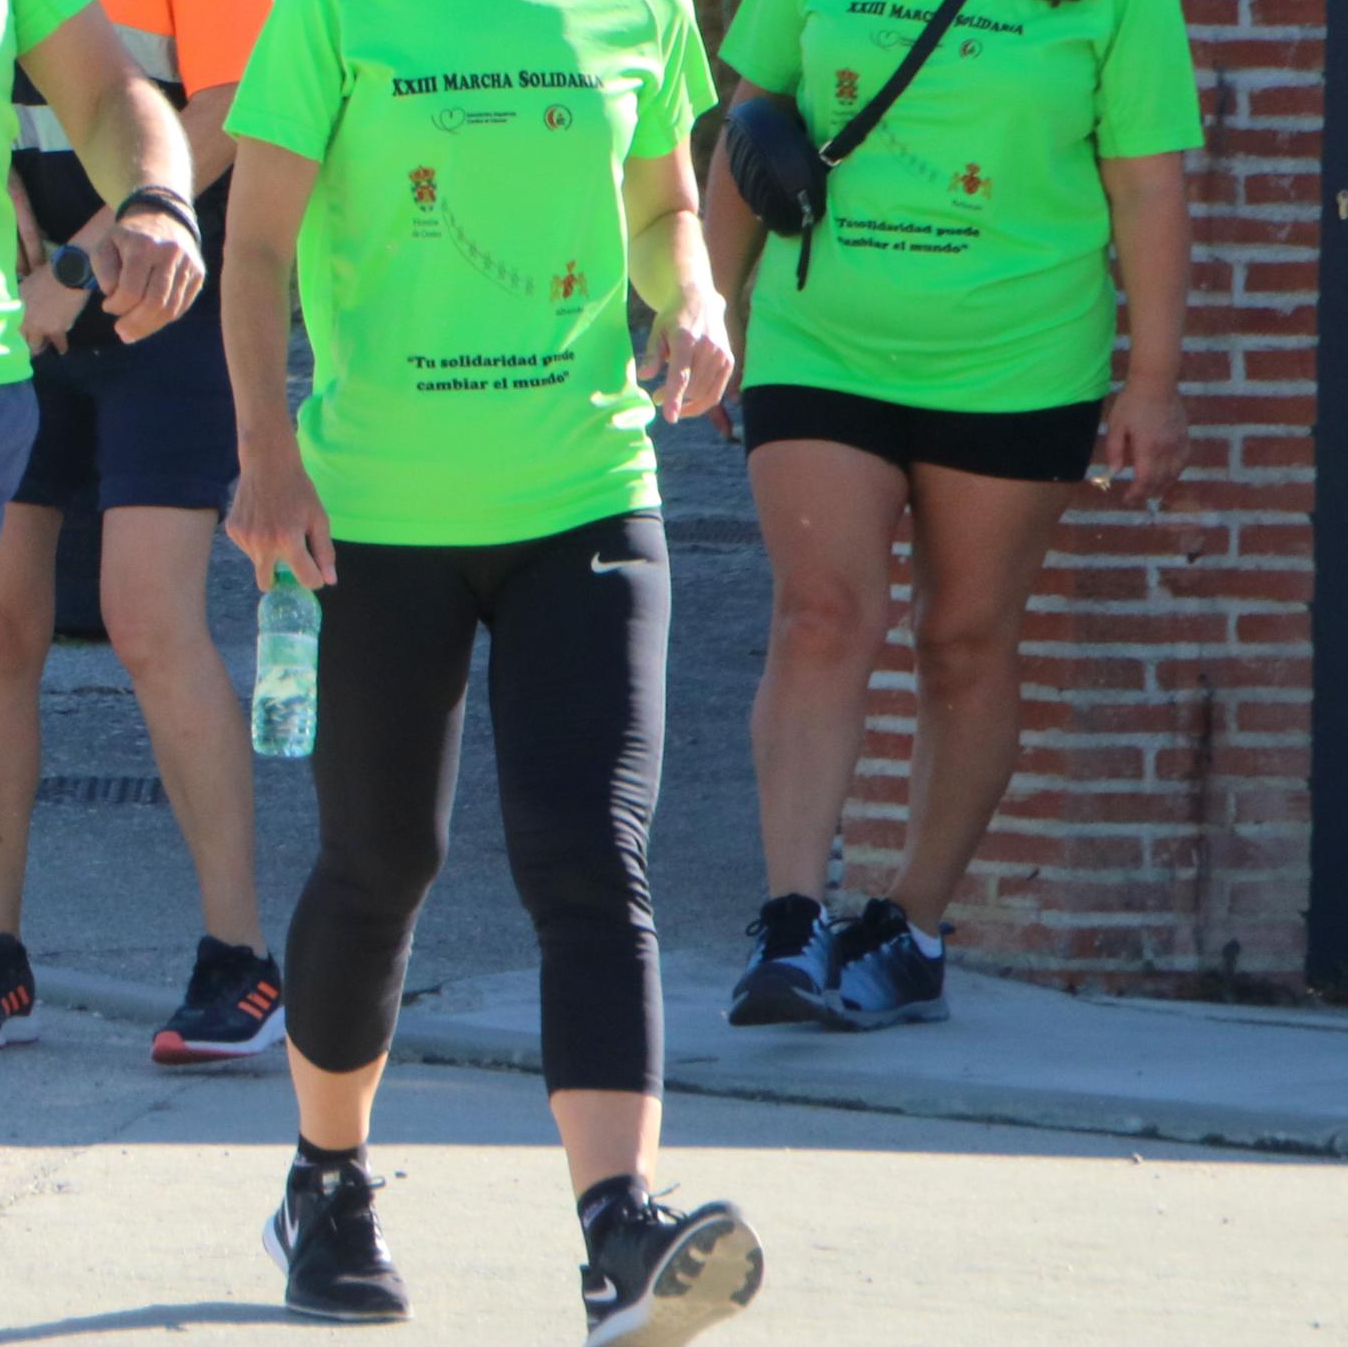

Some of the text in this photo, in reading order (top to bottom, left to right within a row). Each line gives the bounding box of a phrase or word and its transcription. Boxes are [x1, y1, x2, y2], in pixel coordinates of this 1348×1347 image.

[847, 1, 886, 16] XXIII
[392, 76, 438, 97] XXIII
[443, 72, 513, 92] MARCHA
[892, 240, 906, 251] el
[440, 353, 537, 369] solidaridad
[417, 377, 488, 392] cambiar
[494, 376, 509, 391] el
